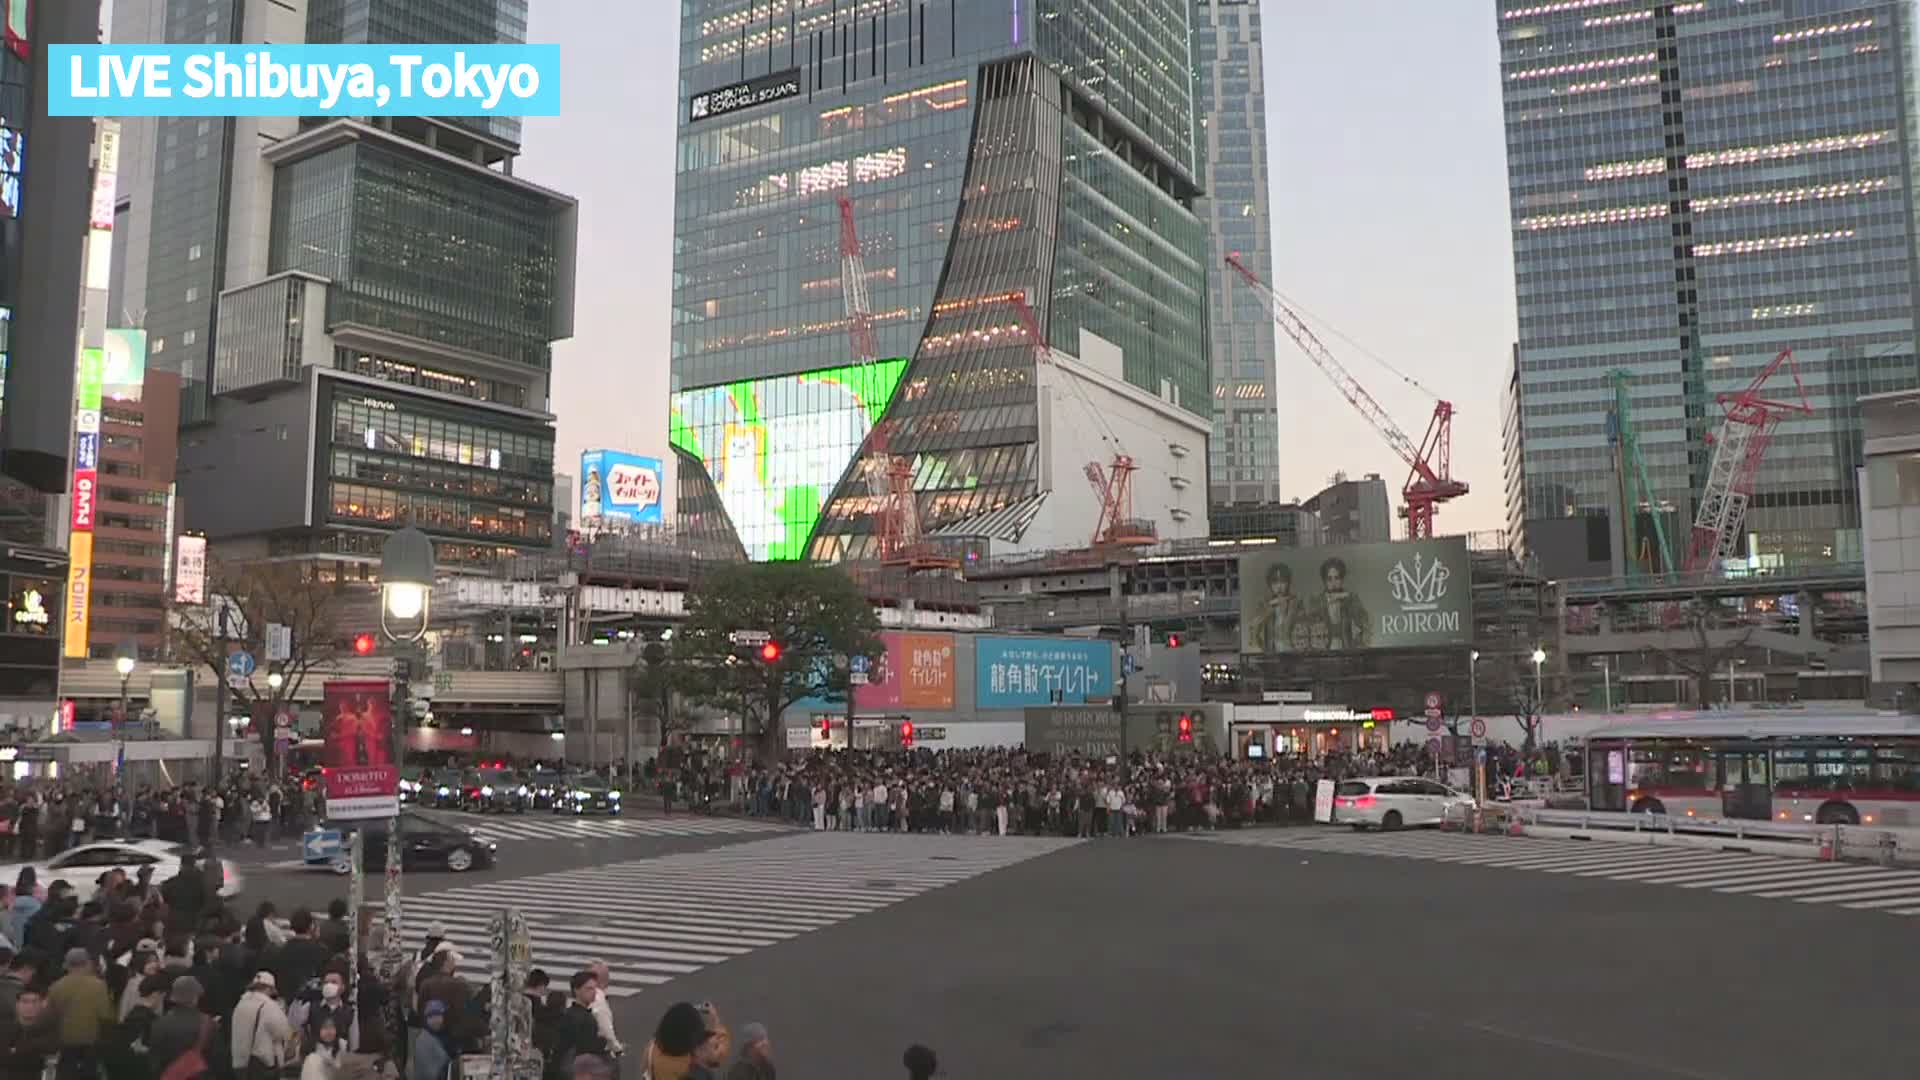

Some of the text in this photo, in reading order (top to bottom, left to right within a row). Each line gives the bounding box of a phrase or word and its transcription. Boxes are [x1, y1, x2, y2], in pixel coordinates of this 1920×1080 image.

[71, 566, 88, 624] プロミス
[1381, 611, 1460, 634] ROIROM
